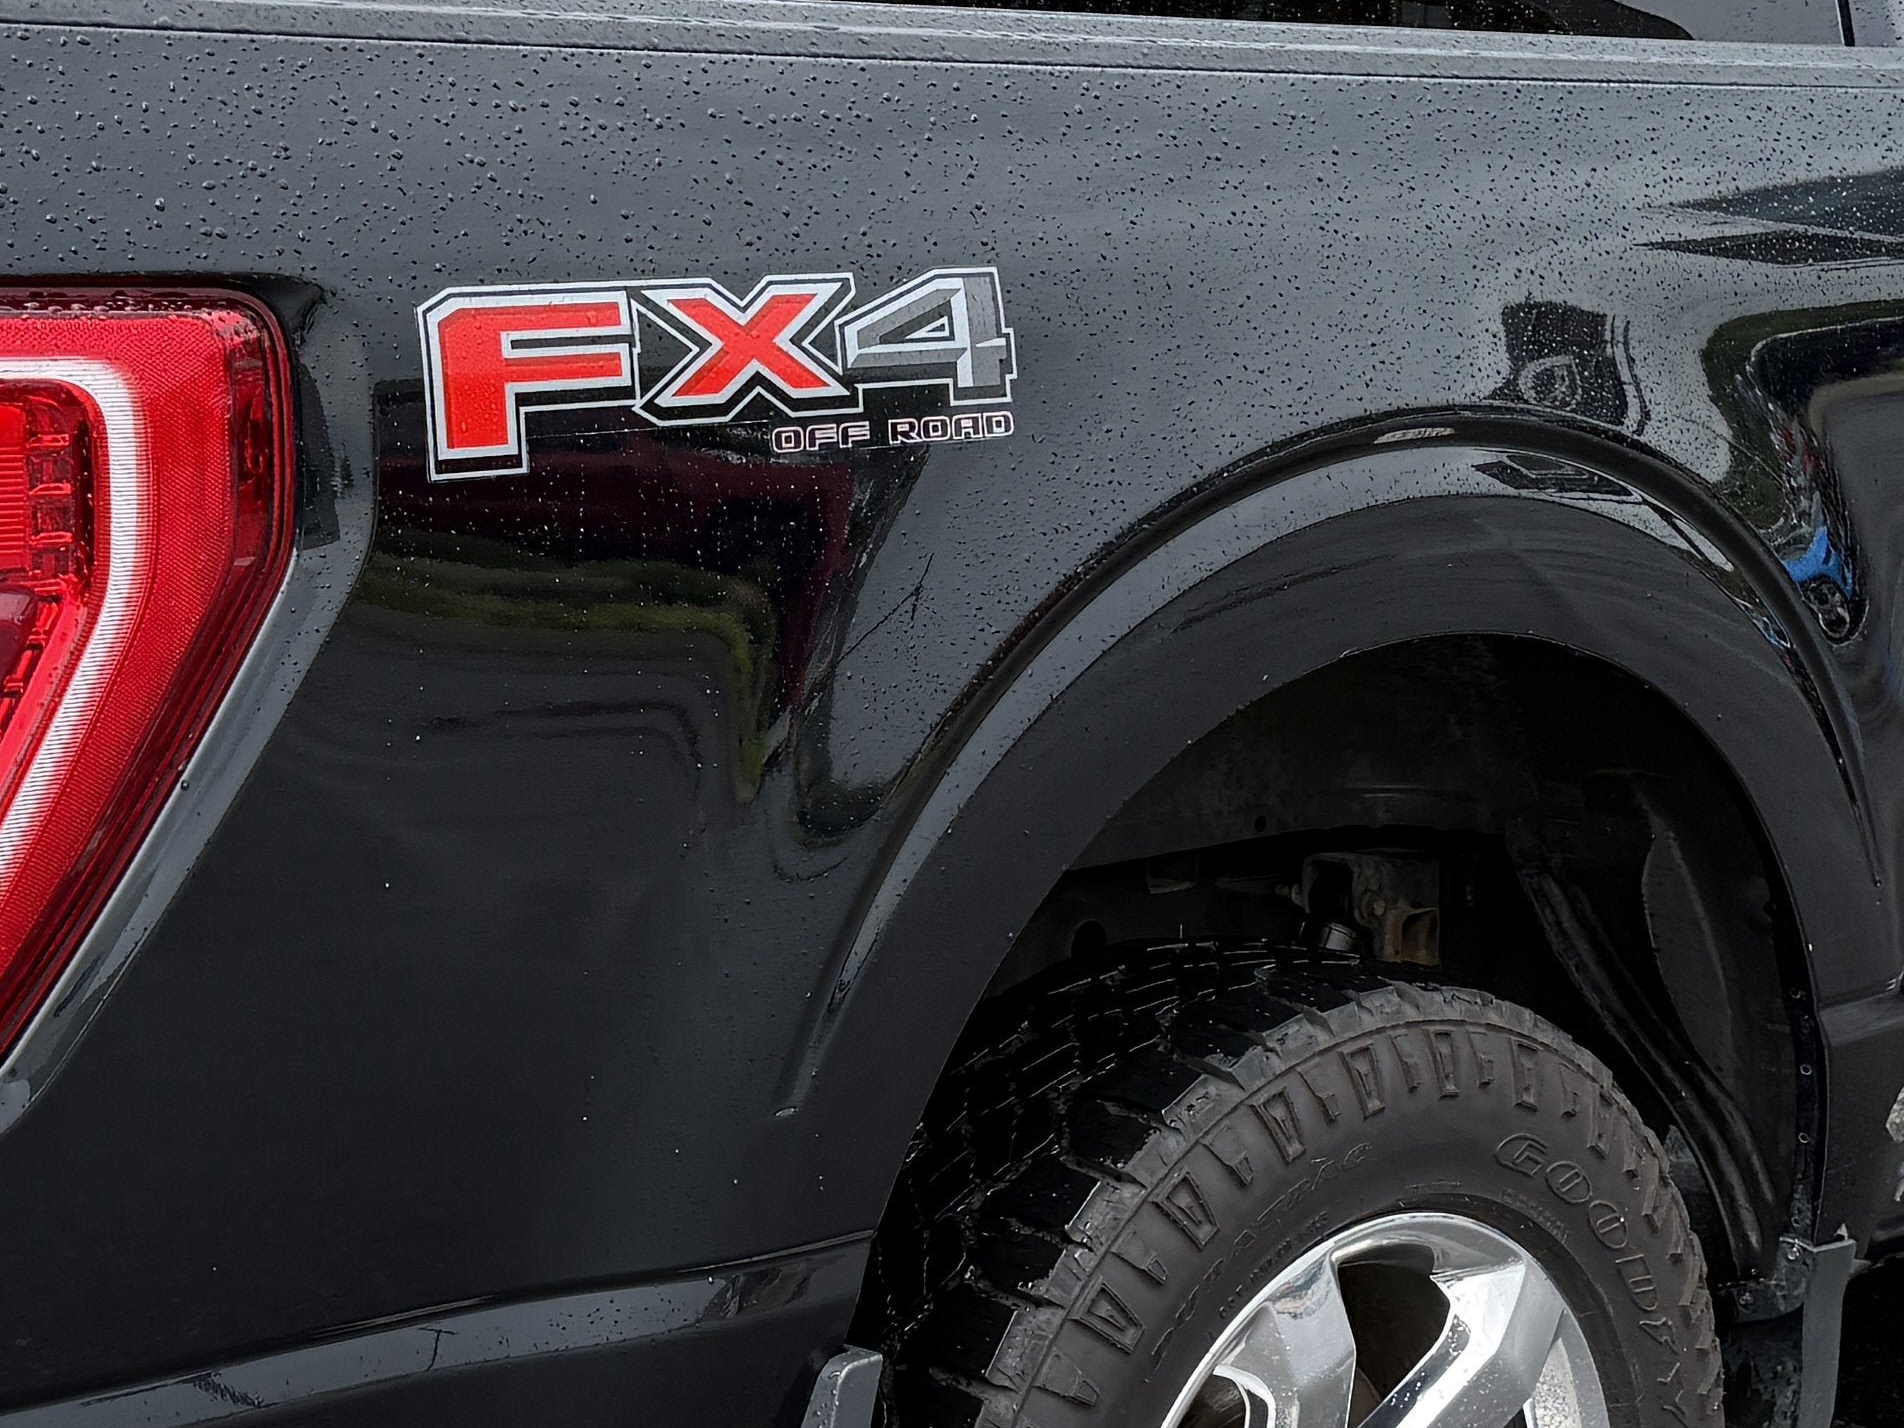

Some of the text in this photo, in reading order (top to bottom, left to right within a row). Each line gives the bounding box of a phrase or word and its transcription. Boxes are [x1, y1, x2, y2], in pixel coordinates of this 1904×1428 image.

[415, 266, 1018, 483] FX4
[772, 410, 1016, 454] OFF ROAD
